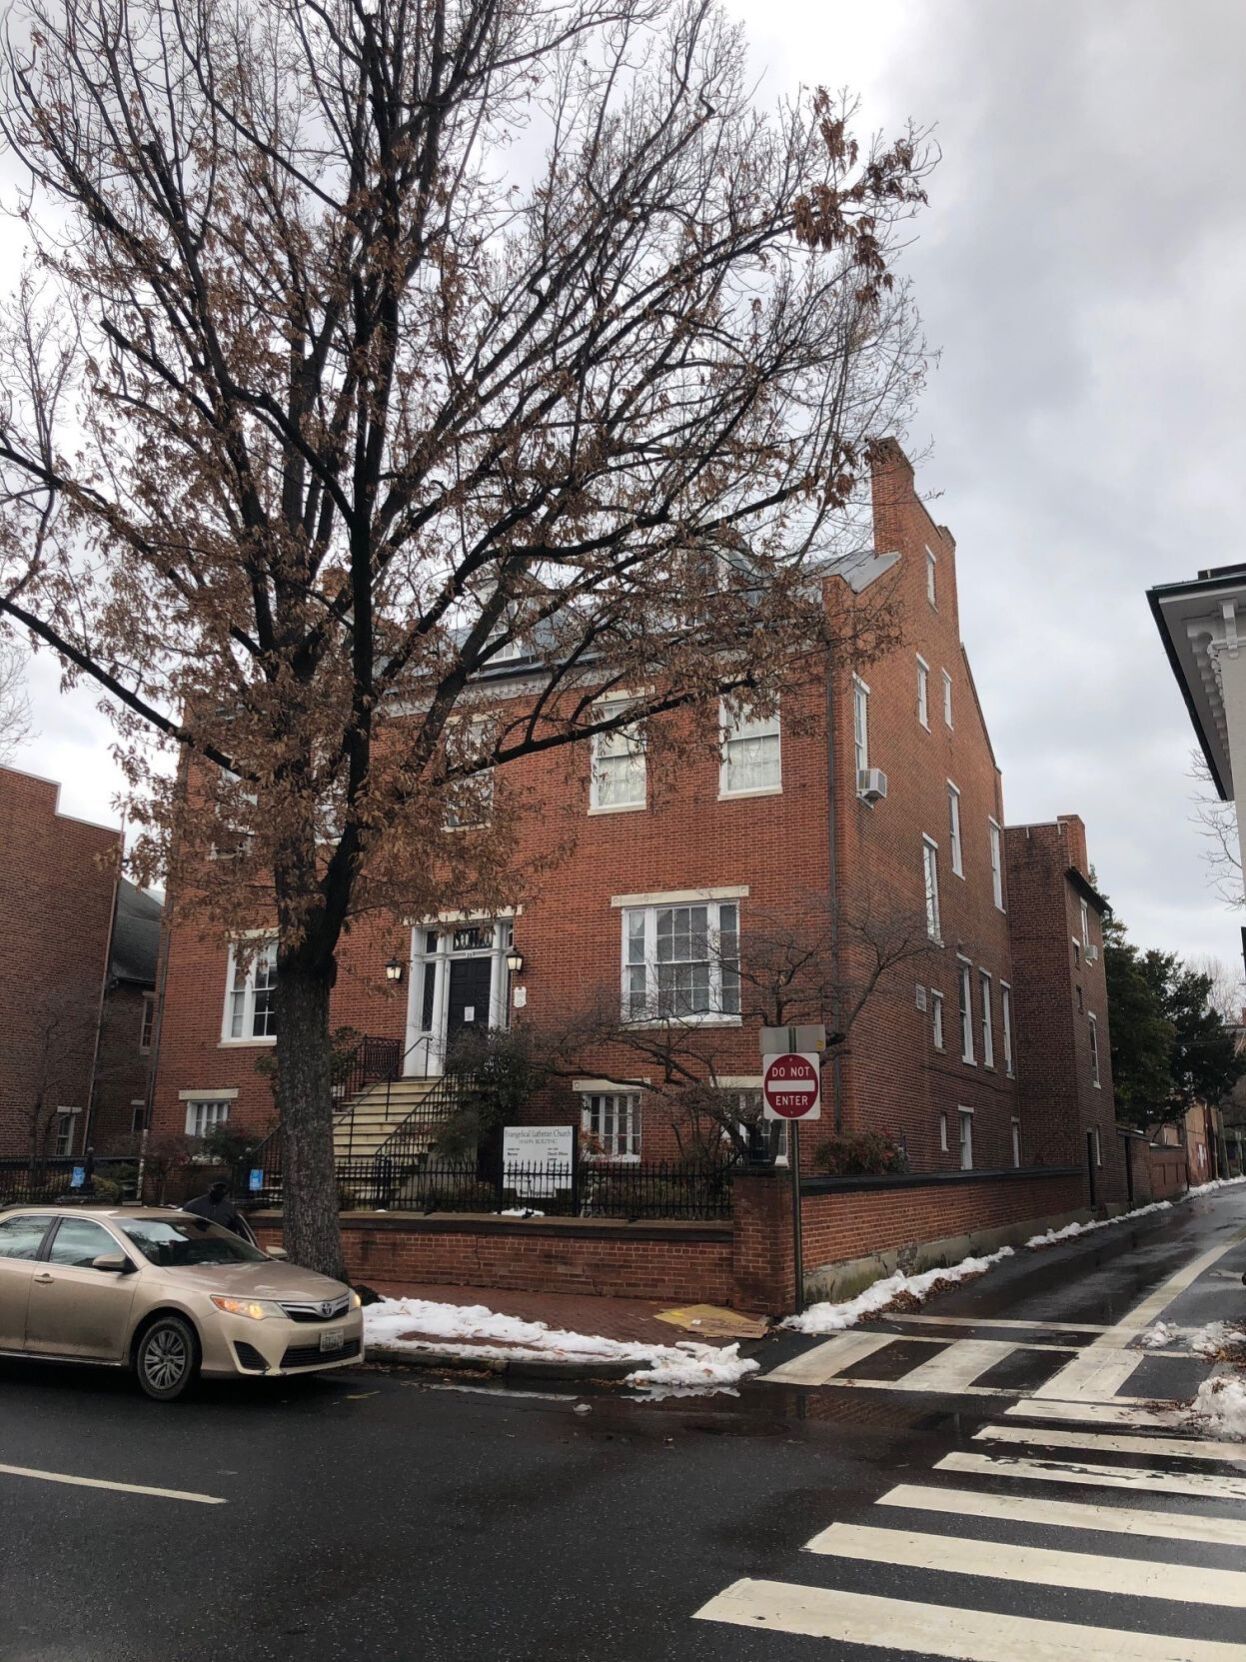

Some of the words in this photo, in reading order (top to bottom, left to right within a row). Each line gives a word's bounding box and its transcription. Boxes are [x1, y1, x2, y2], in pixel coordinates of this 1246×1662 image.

[772, 1067, 785, 1077] DO
[791, 1066, 810, 1076] NOT
[776, 1095, 808, 1106] ENTER
